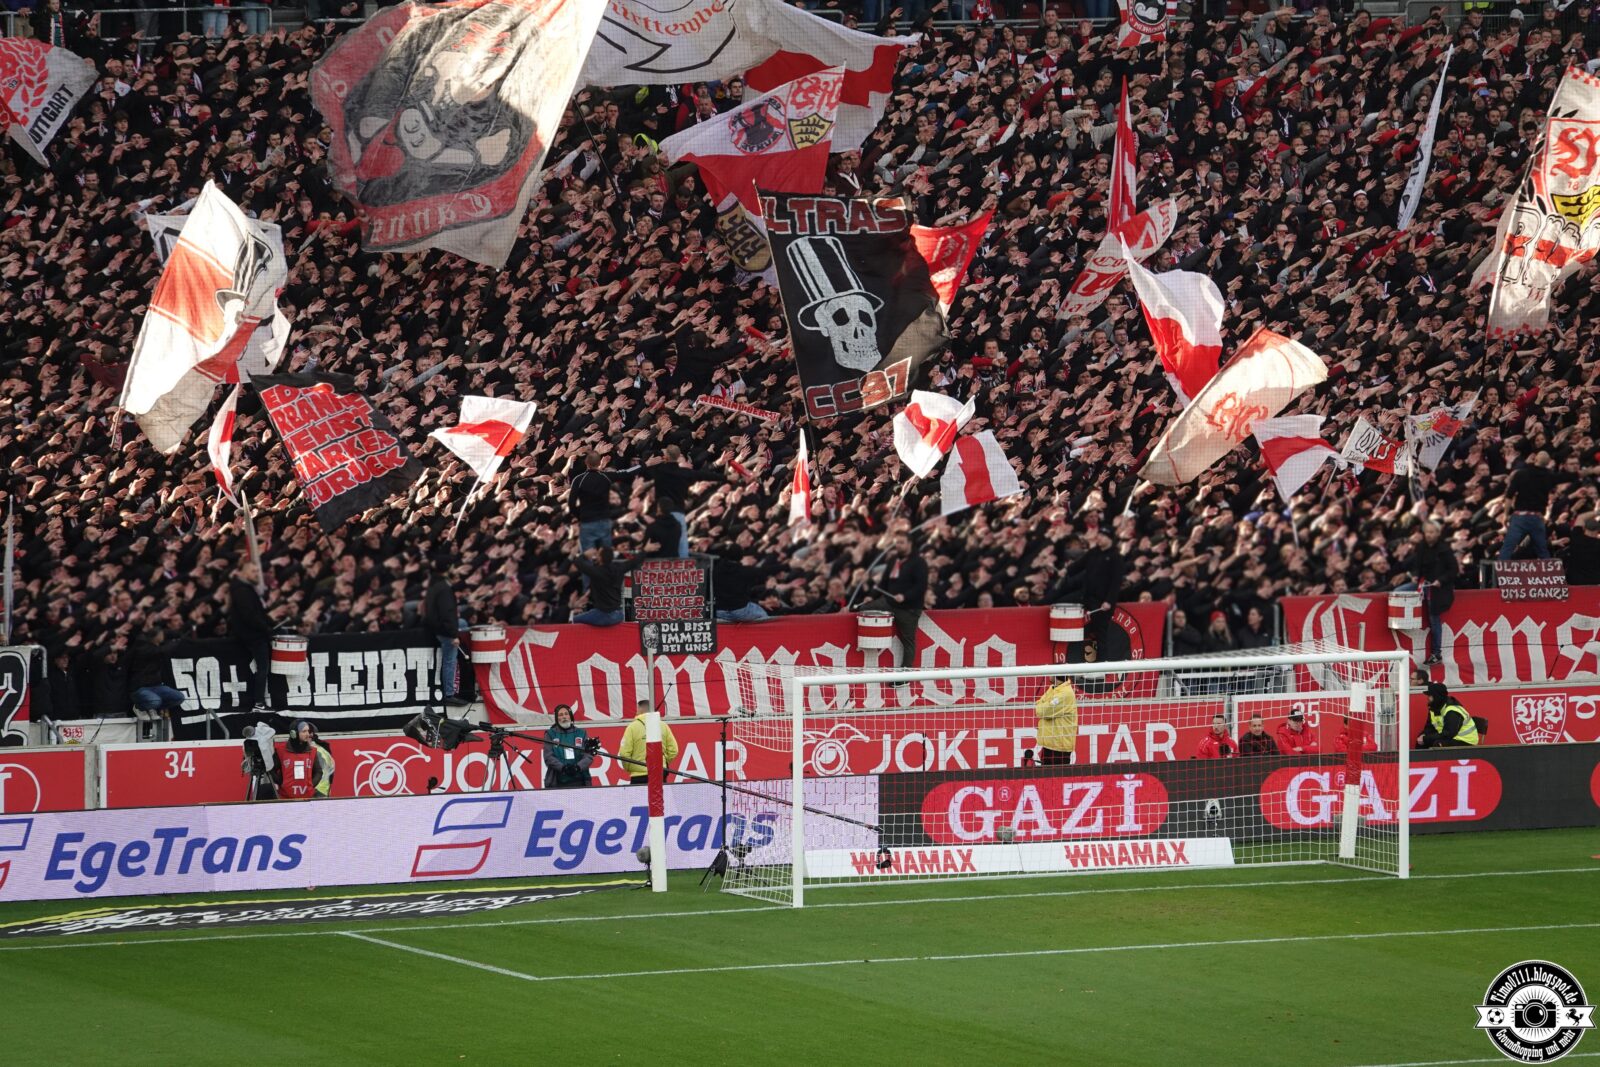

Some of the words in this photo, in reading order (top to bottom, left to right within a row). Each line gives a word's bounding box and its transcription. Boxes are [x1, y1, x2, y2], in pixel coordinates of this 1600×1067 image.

[641, 560, 697, 570] JEDER
[1494, 561, 1537, 572] ULTRA
[1541, 560, 1563, 572] IST
[633, 569, 704, 585] VERBANNTE
[1497, 576, 1522, 586] DER
[1527, 575, 1566, 585] KAMPF
[641, 584, 699, 596] KEHRT
[1501, 588, 1526, 599] UMS
[1528, 587, 1569, 600] GANZE
[661, 622, 679, 632] DU
[684, 621, 712, 632] BIST
[661, 632, 712, 644] IMMER
[662, 644, 681, 653] BEI
[685, 643, 713, 652] UNS!
[488, 611, 1018, 725] Commando
[286, 647, 443, 707] BLEIBT!
[869, 723, 1177, 774] JOKERTAR
[165, 751, 195, 779] 34
[292, 785, 307, 795] TV
[524, 806, 780, 870] EgeTrans
[44, 826, 308, 893] EgeTrans
[1065, 841, 1190, 868] WINAMAX
